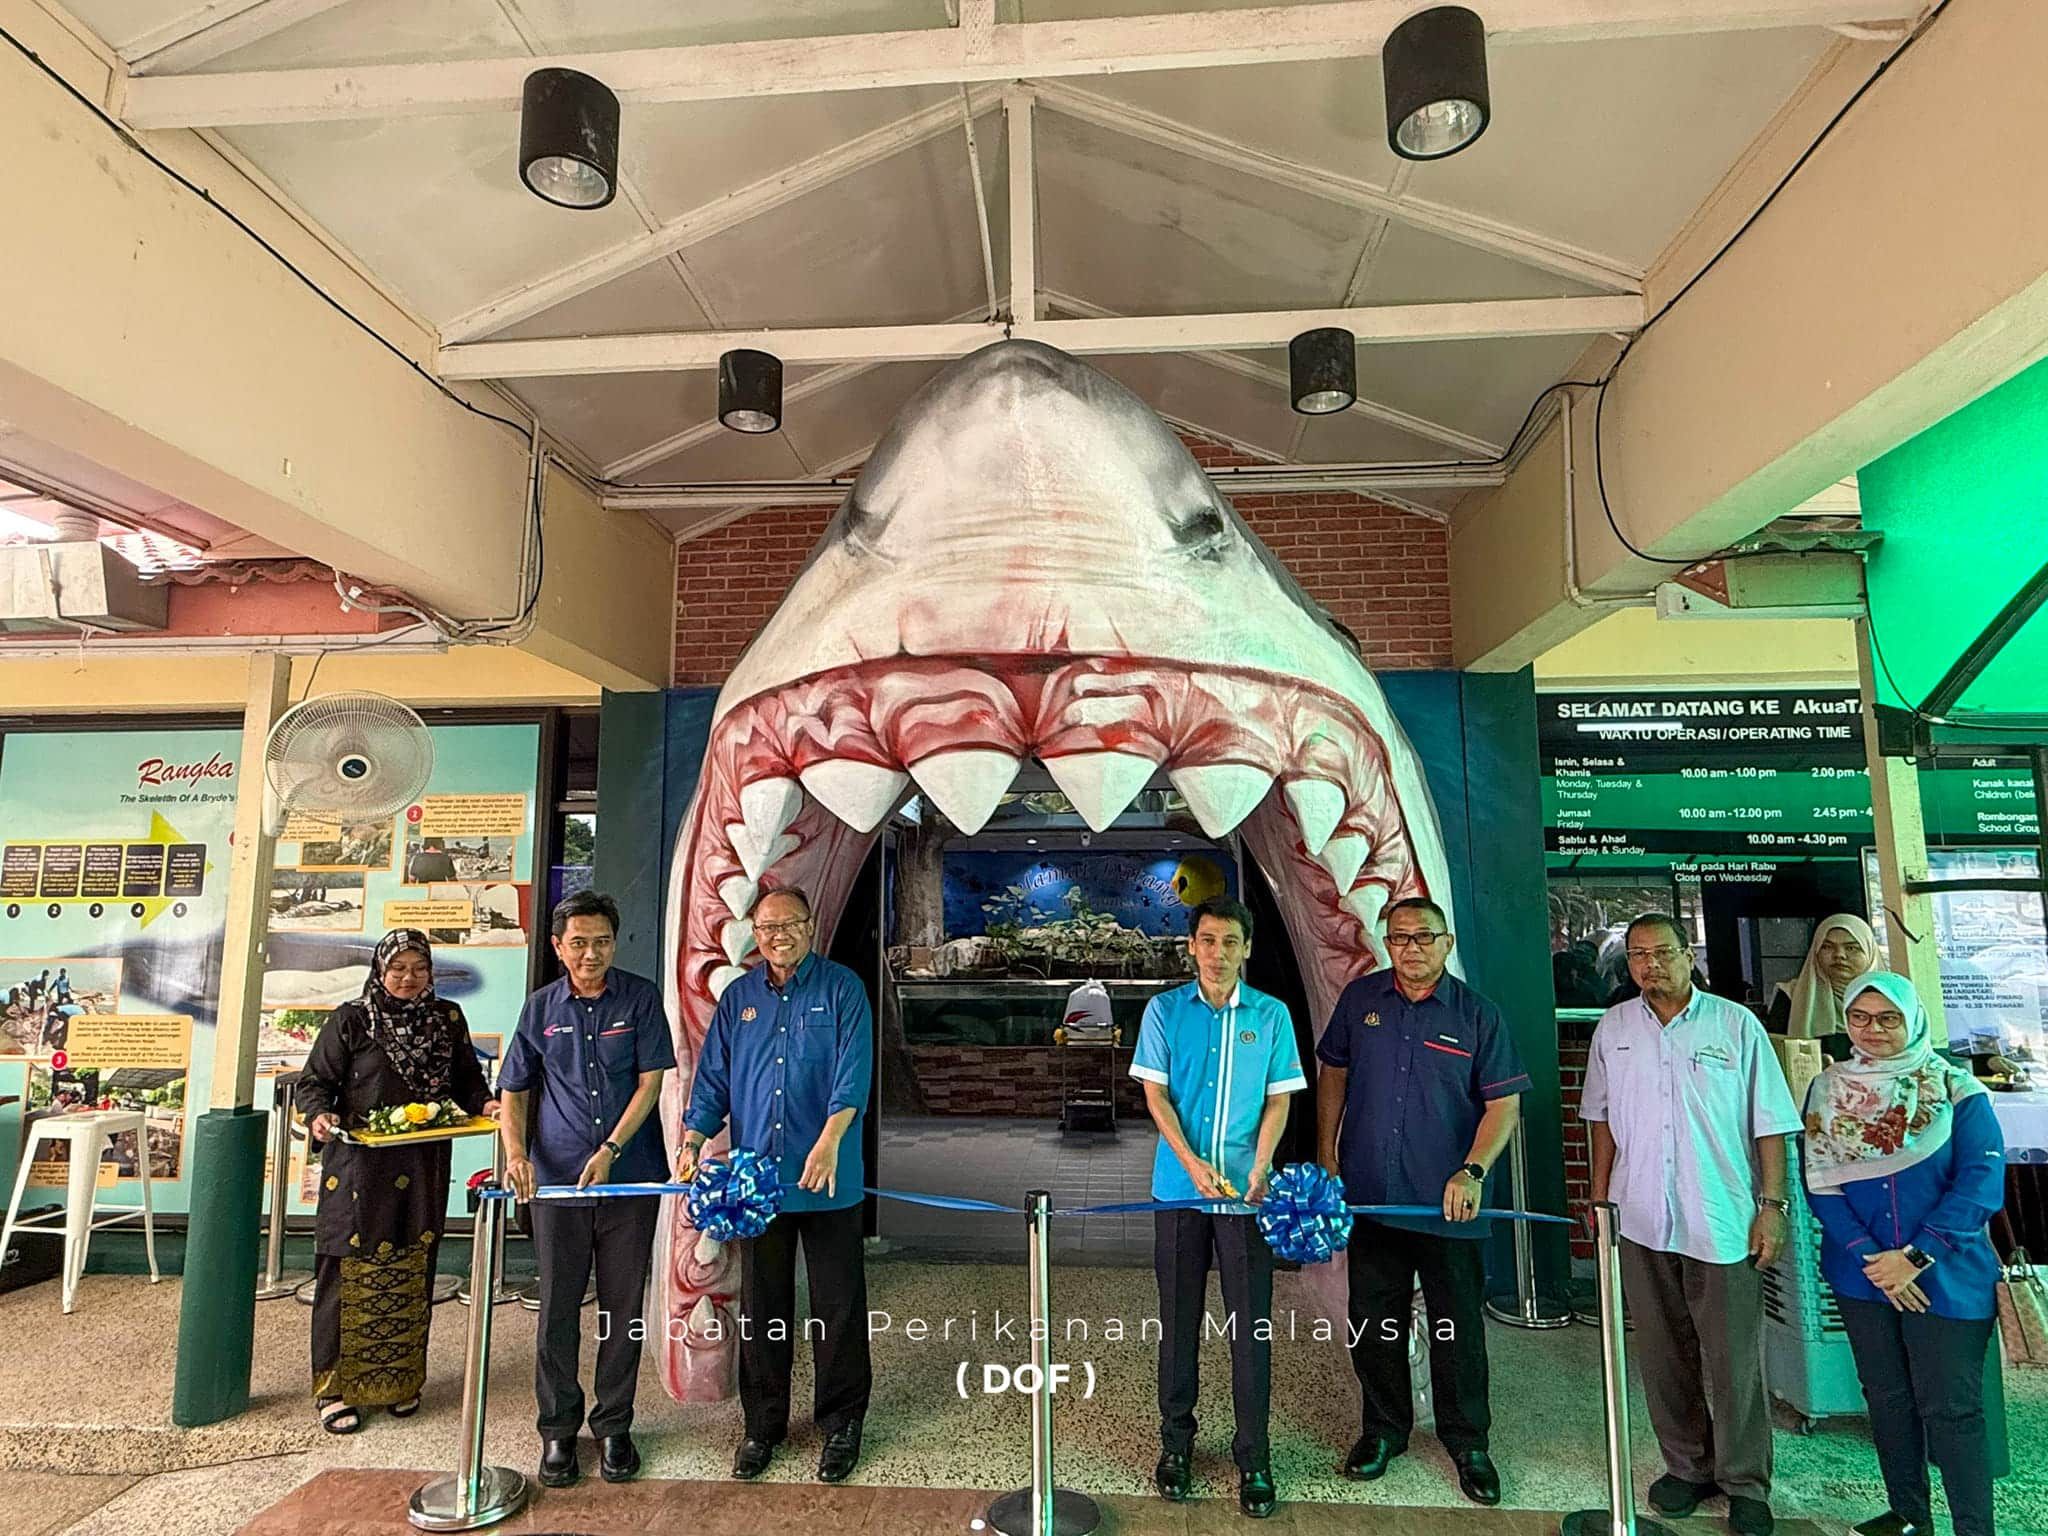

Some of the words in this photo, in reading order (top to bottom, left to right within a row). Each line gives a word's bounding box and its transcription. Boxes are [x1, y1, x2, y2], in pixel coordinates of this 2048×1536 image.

[1557, 702, 1656, 718] SELAMAT
[1661, 701, 1744, 716] DATANG
[1750, 700, 1780, 715] KE
[1599, 729, 1652, 740] WAKTU
[1816, 726, 1851, 739] TIME
[1554, 757, 1580, 767] Isnin,
[1582, 757, 1614, 766] Selasa
[1616, 757, 1625, 766] &
[138, 751, 235, 789] Rangka
[1555, 768, 1591, 777] Khamis
[1681, 769, 1708, 778] 10.00
[1758, 770, 1777, 780] pm
[1811, 768, 1834, 778] 2.00
[1836, 769, 1855, 779] pm
[1556, 779, 1593, 789] Monday,
[1596, 779, 1632, 789] Tuesday
[1635, 779, 1643, 788] &
[1972, 779, 2005, 788] Kanak
[120, 794, 137, 803] The
[179, 794, 190, 802] Of
[191, 794, 199, 802] A
[1557, 790, 1598, 801] Thursday
[1974, 790, 2012, 799] Children
[1556, 809, 1592, 818] Jumaat
[1678, 808, 1706, 818] 10.00
[1708, 810, 1726, 818] am
[1764, 810, 1783, 820] pm
[1812, 807, 1838, 818] 2.45
[1838, 809, 1858, 819] pm
[1977, 812, 2038, 823] Rombongan
[1556, 820, 1585, 830] Friday
[1978, 823, 2012, 833] School
[1558, 835, 1587, 844] Sabtu
[1589, 835, 1598, 844] &
[1600, 834, 1627, 844] Ahad
[1746, 834, 1775, 844] 10.00
[1777, 836, 1795, 844] am
[1828, 836, 1847, 846] pm
[1559, 846, 1598, 856] Saturday
[1601, 846, 1609, 855] &
[1612, 845, 1646, 856] Sunday
[1670, 862, 1698, 872] Tutup
[1700, 863, 1725, 873] pada
[1727, 861, 1748, 871] Hari
[1750, 861, 1777, 871] Rabu
[1674, 873, 1701, 882] Close
[1719, 872, 1773, 884] Wednesday
